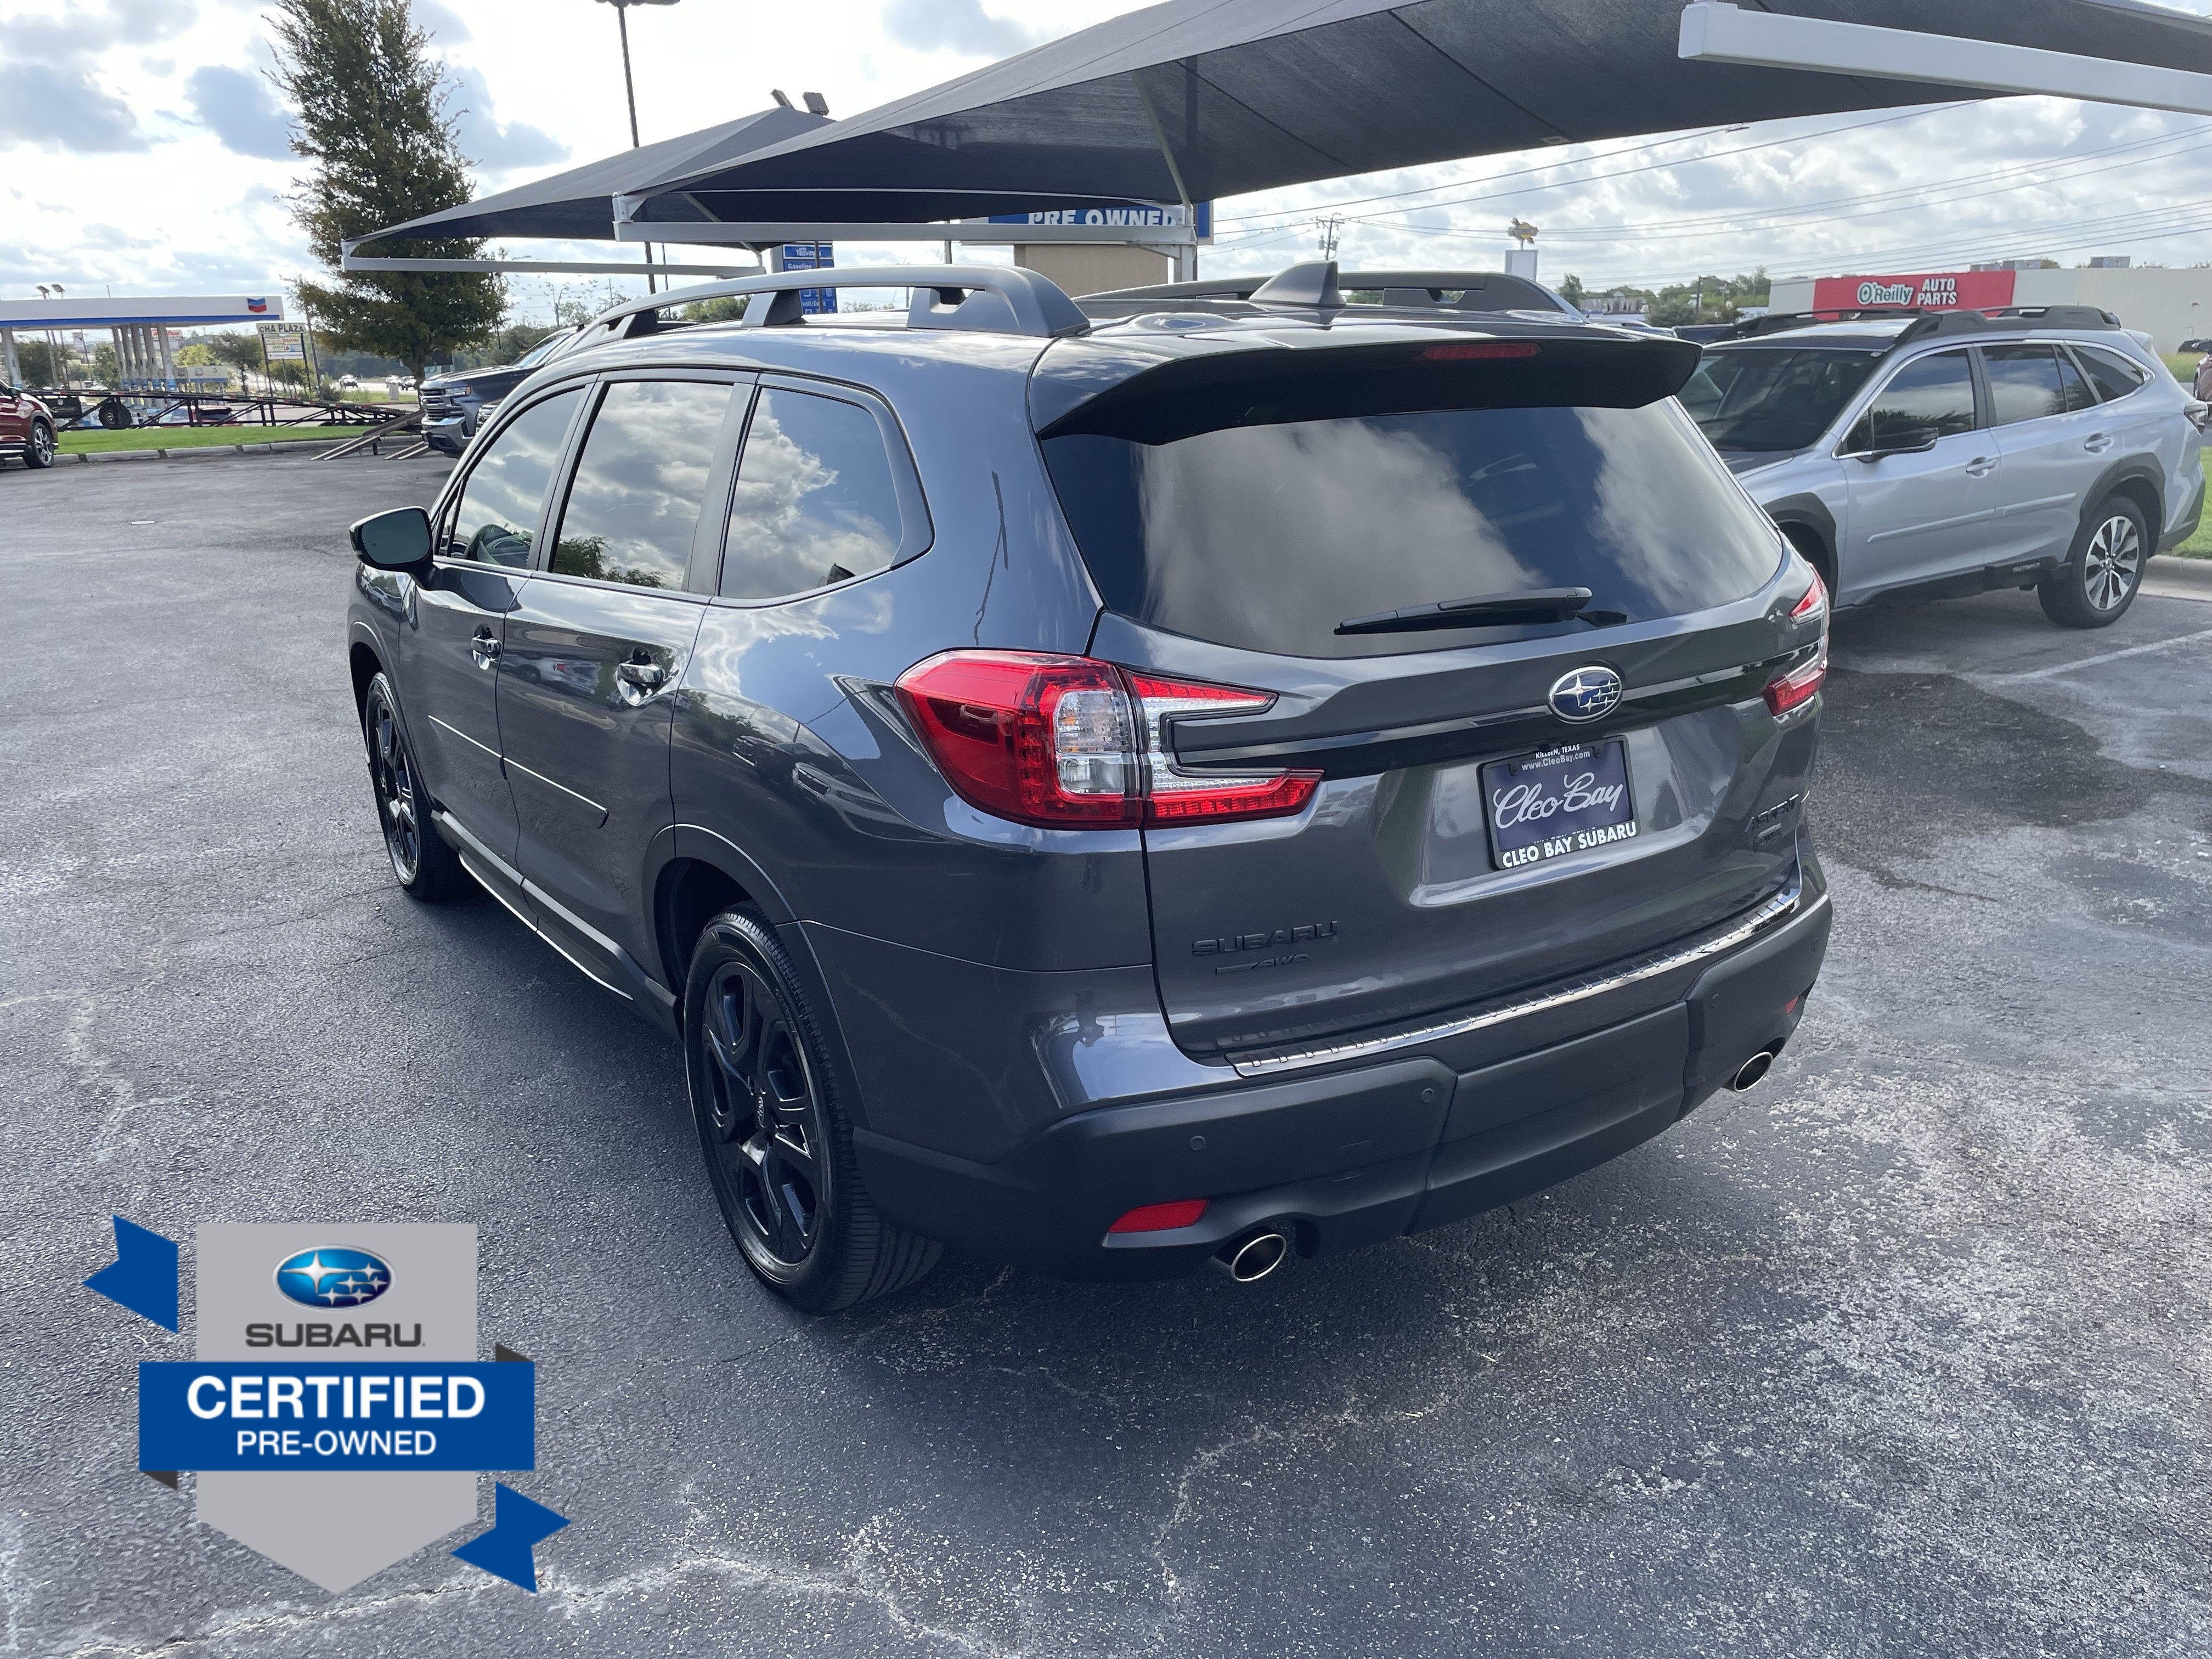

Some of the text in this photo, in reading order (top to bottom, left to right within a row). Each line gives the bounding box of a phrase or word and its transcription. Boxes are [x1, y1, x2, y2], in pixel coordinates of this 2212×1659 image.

[1028, 209, 1177, 225] PRE OWNED
[1858, 283, 1914, 304] O'Reilly
[1922, 278, 1956, 292] AUTO
[1917, 291, 1957, 306] PARTS
[259, 324, 304, 333] CHA PLAZA
[1561, 744, 1580, 753] TEXAS
[1521, 751, 1590, 771] www.CleoBay.com
[1493, 772, 1623, 829] Cleo Bay
[1502, 845, 1539, 868] CLEO
[1544, 837, 1572, 858] BAY
[1578, 821, 1637, 849] SUBARU
[1192, 921, 1338, 957] SUBARU
